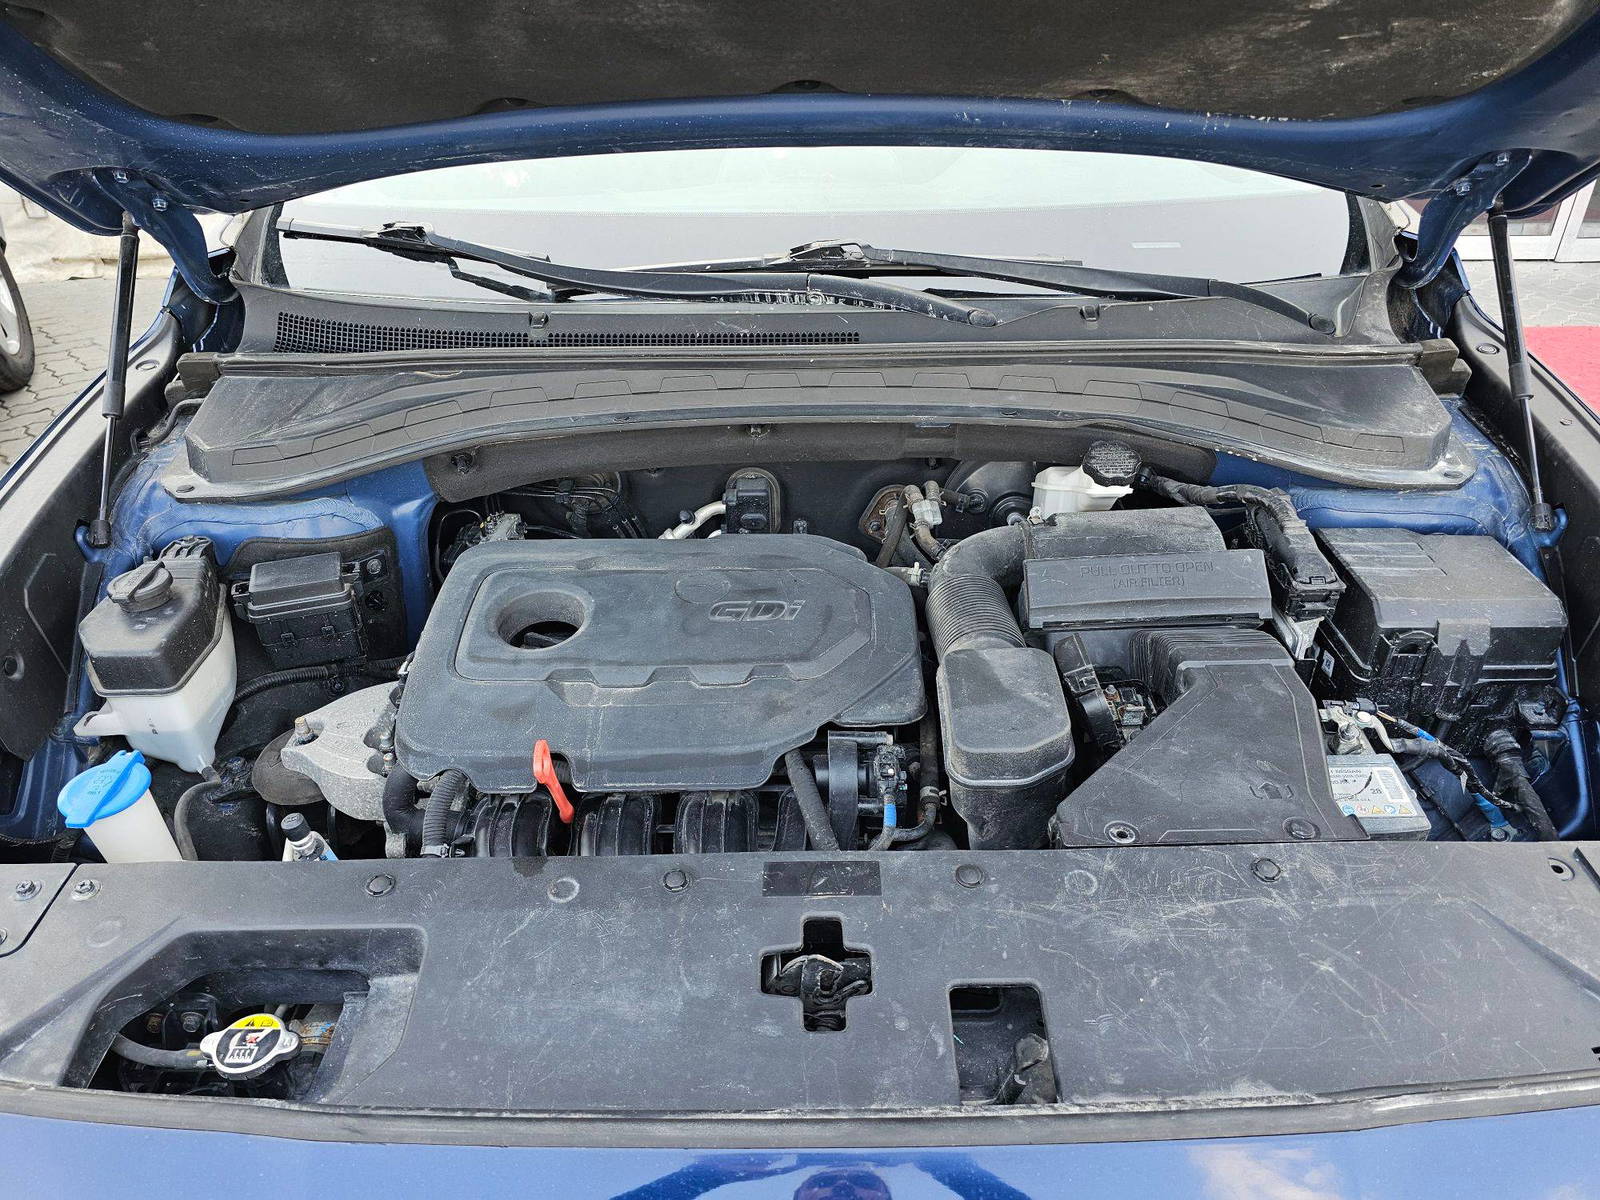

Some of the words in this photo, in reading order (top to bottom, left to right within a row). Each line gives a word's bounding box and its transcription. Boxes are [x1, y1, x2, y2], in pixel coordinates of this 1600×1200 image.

[1080, 565, 1117, 577] PULL
[1120, 563, 1148, 575] OUT
[1153, 562, 1172, 574] TO
[1175, 561, 1214, 573] OPEN
